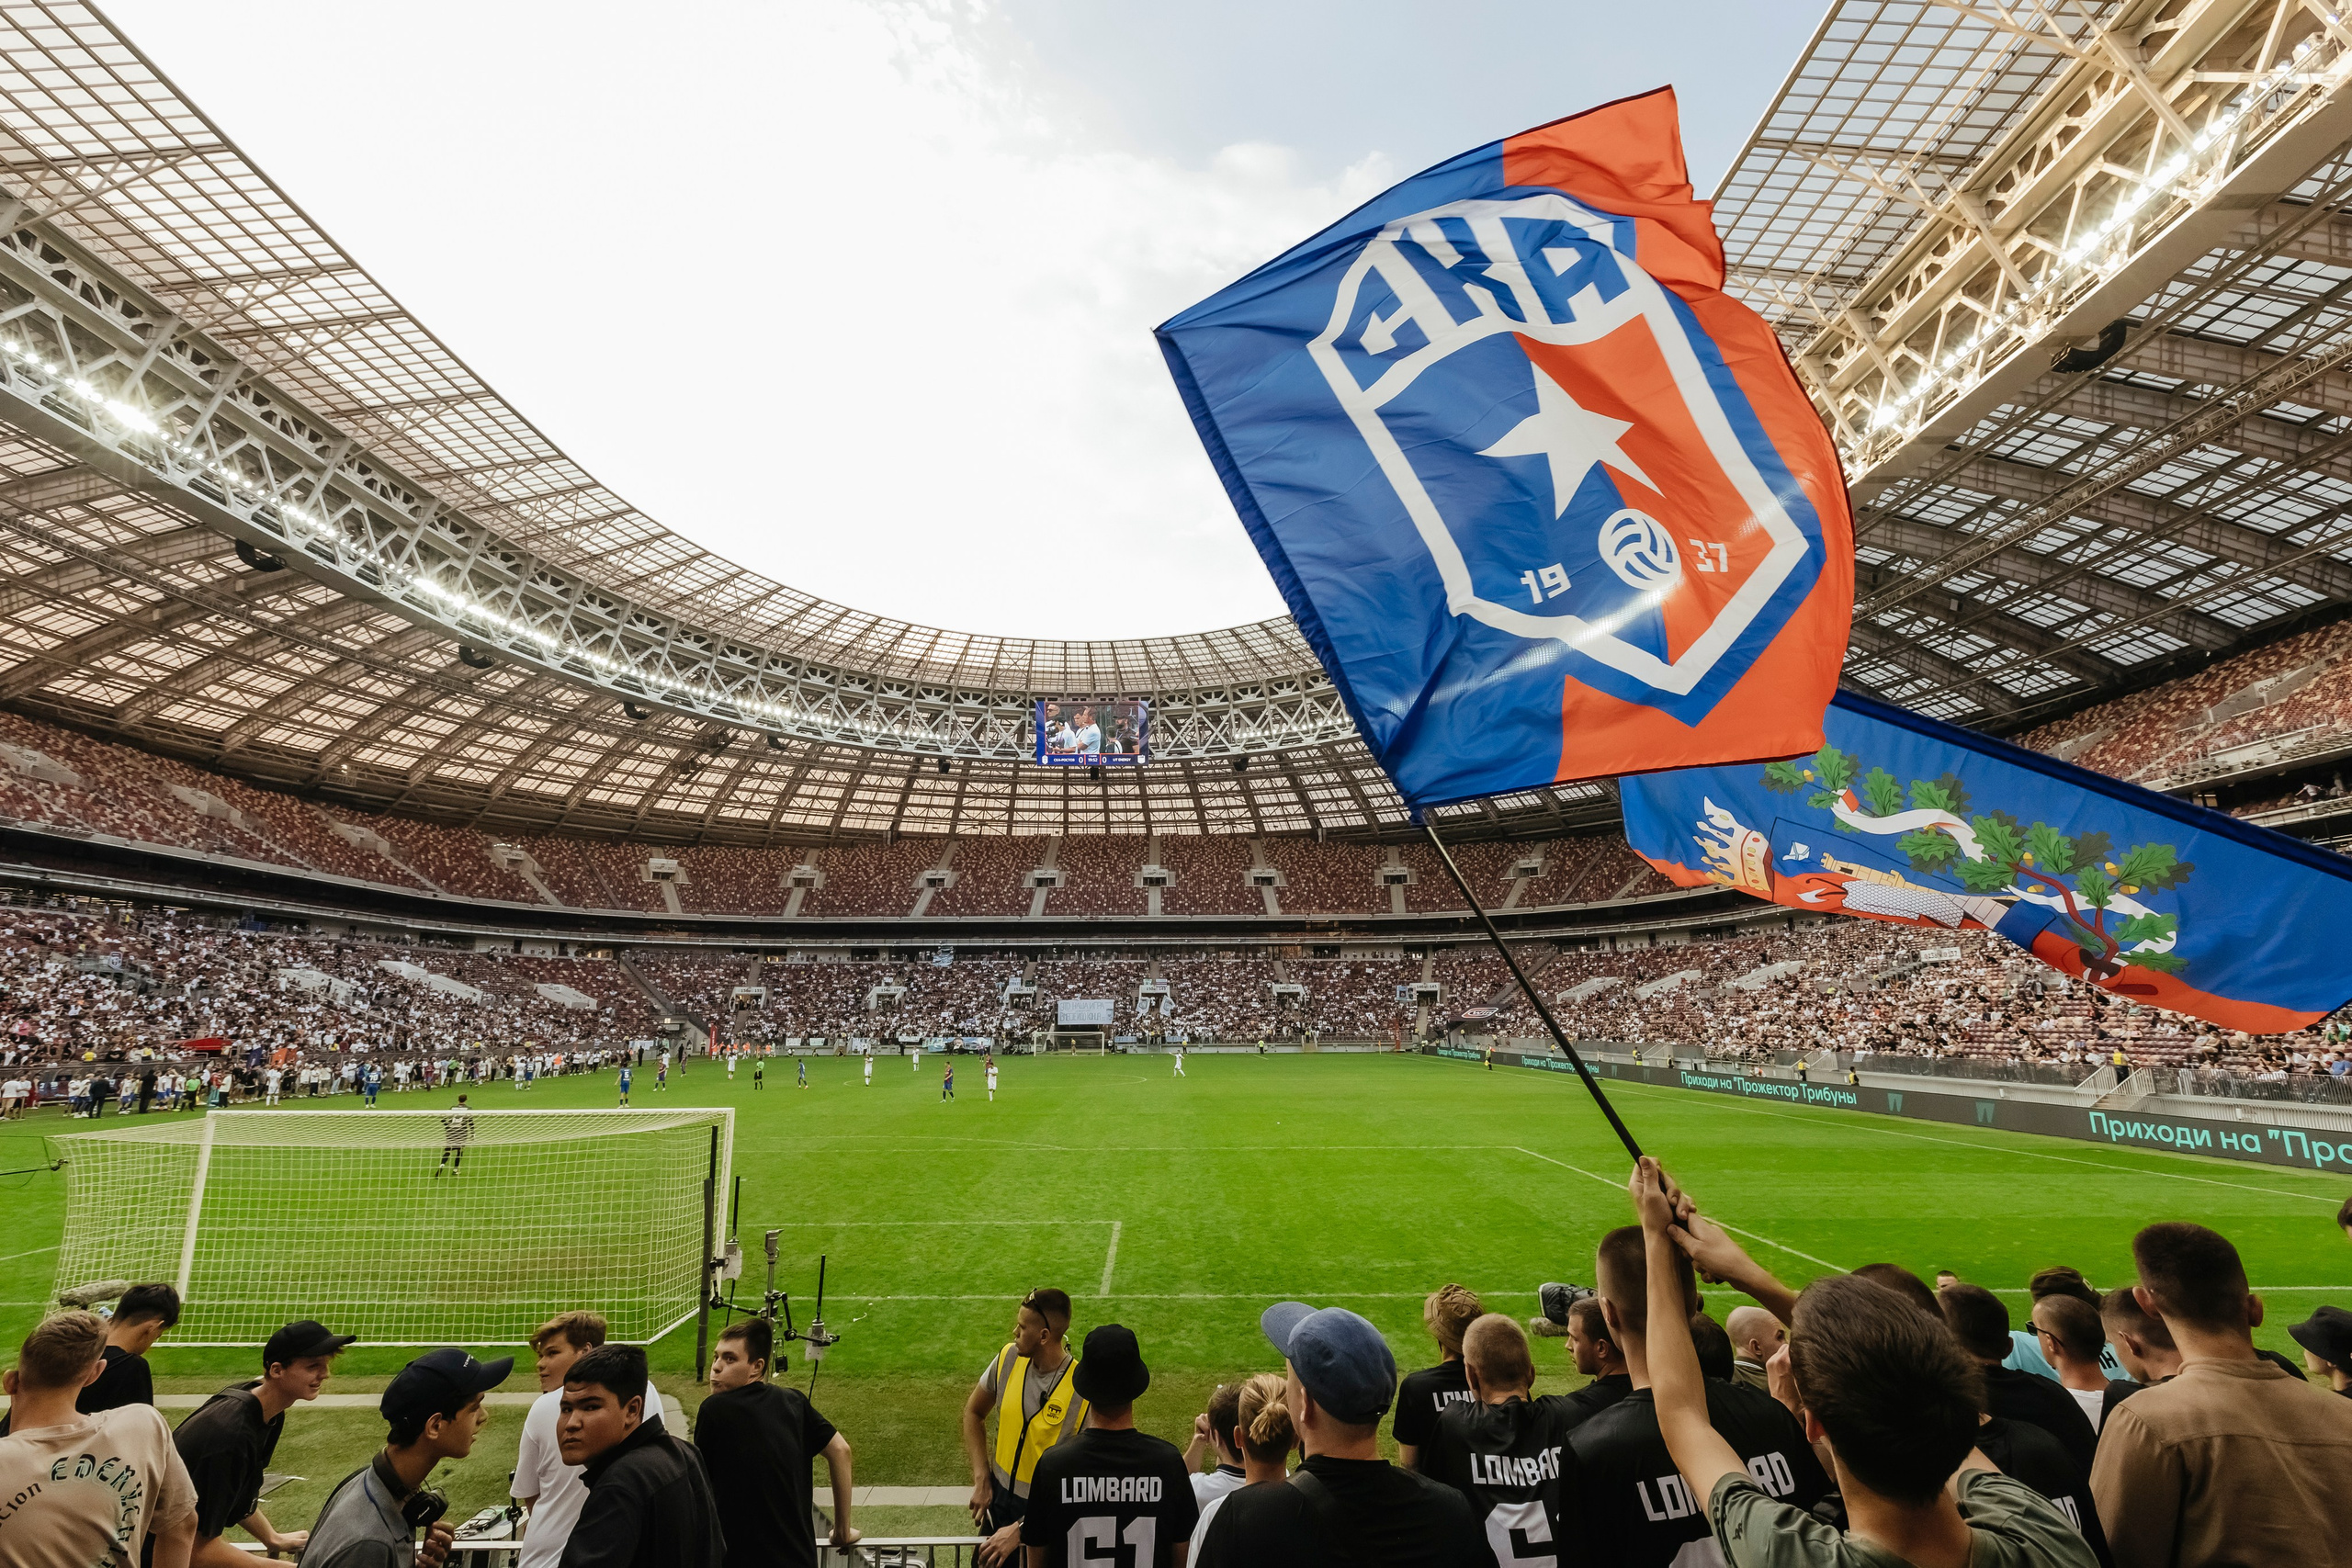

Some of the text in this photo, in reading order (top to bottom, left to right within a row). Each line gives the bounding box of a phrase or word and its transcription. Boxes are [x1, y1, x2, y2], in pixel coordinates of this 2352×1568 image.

[1521, 538, 1728, 604] 19 37
[1521, 1055, 1540, 1067] Приходи
[1540, 1059, 1546, 1067] на
[1680, 1071, 1857, 1106] Приходи на "Прожектор Трибуны
[2088, 1111, 2212, 1149] Приходи
[2220, 1131, 2262, 1154] на
[1061, 1476, 1162, 1504] LOMBARD
